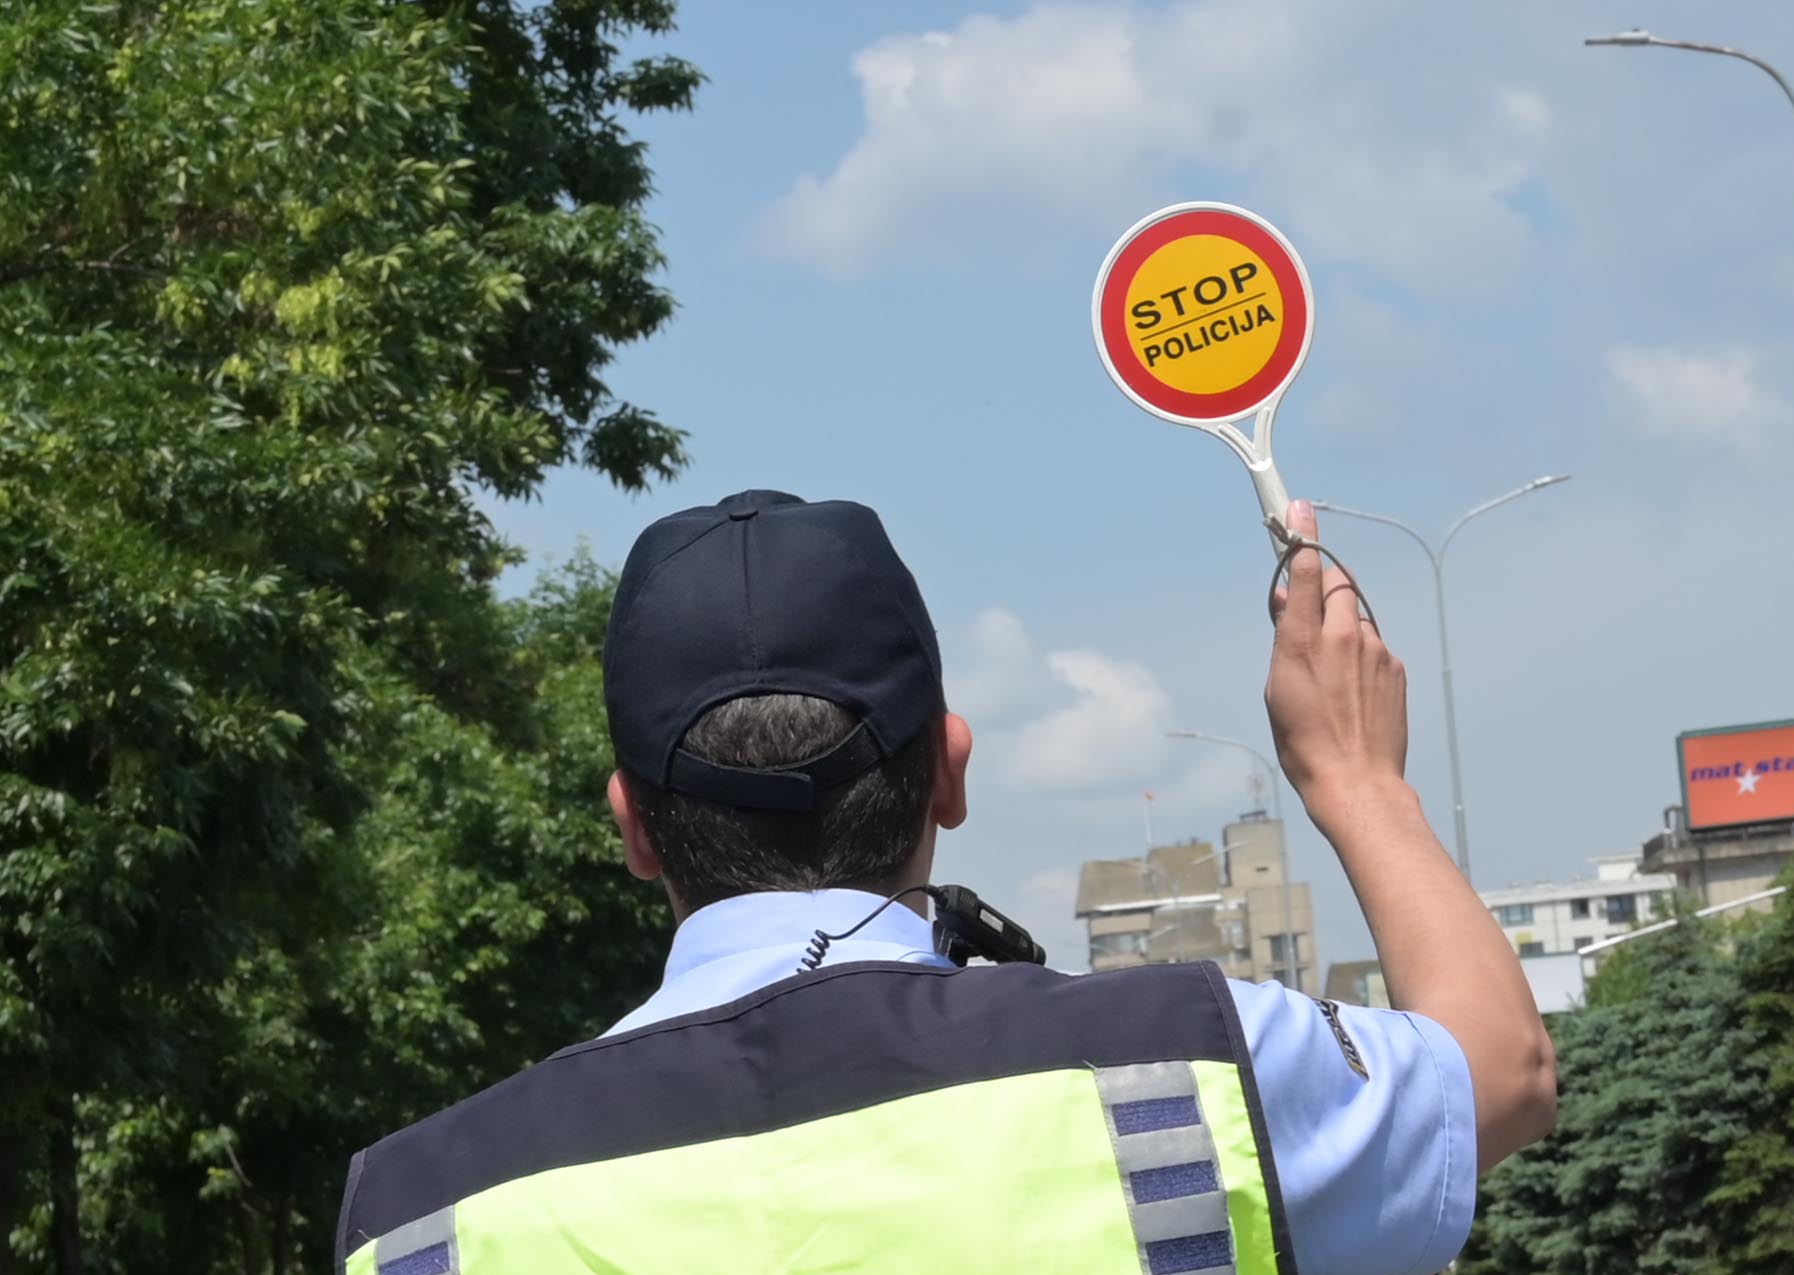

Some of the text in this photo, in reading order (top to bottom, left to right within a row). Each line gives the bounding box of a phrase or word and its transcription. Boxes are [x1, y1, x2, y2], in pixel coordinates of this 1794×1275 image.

[1131, 262, 1258, 329] STOP
[1143, 304, 1276, 367] POLICIJA
[1690, 760, 1744, 782] mat
